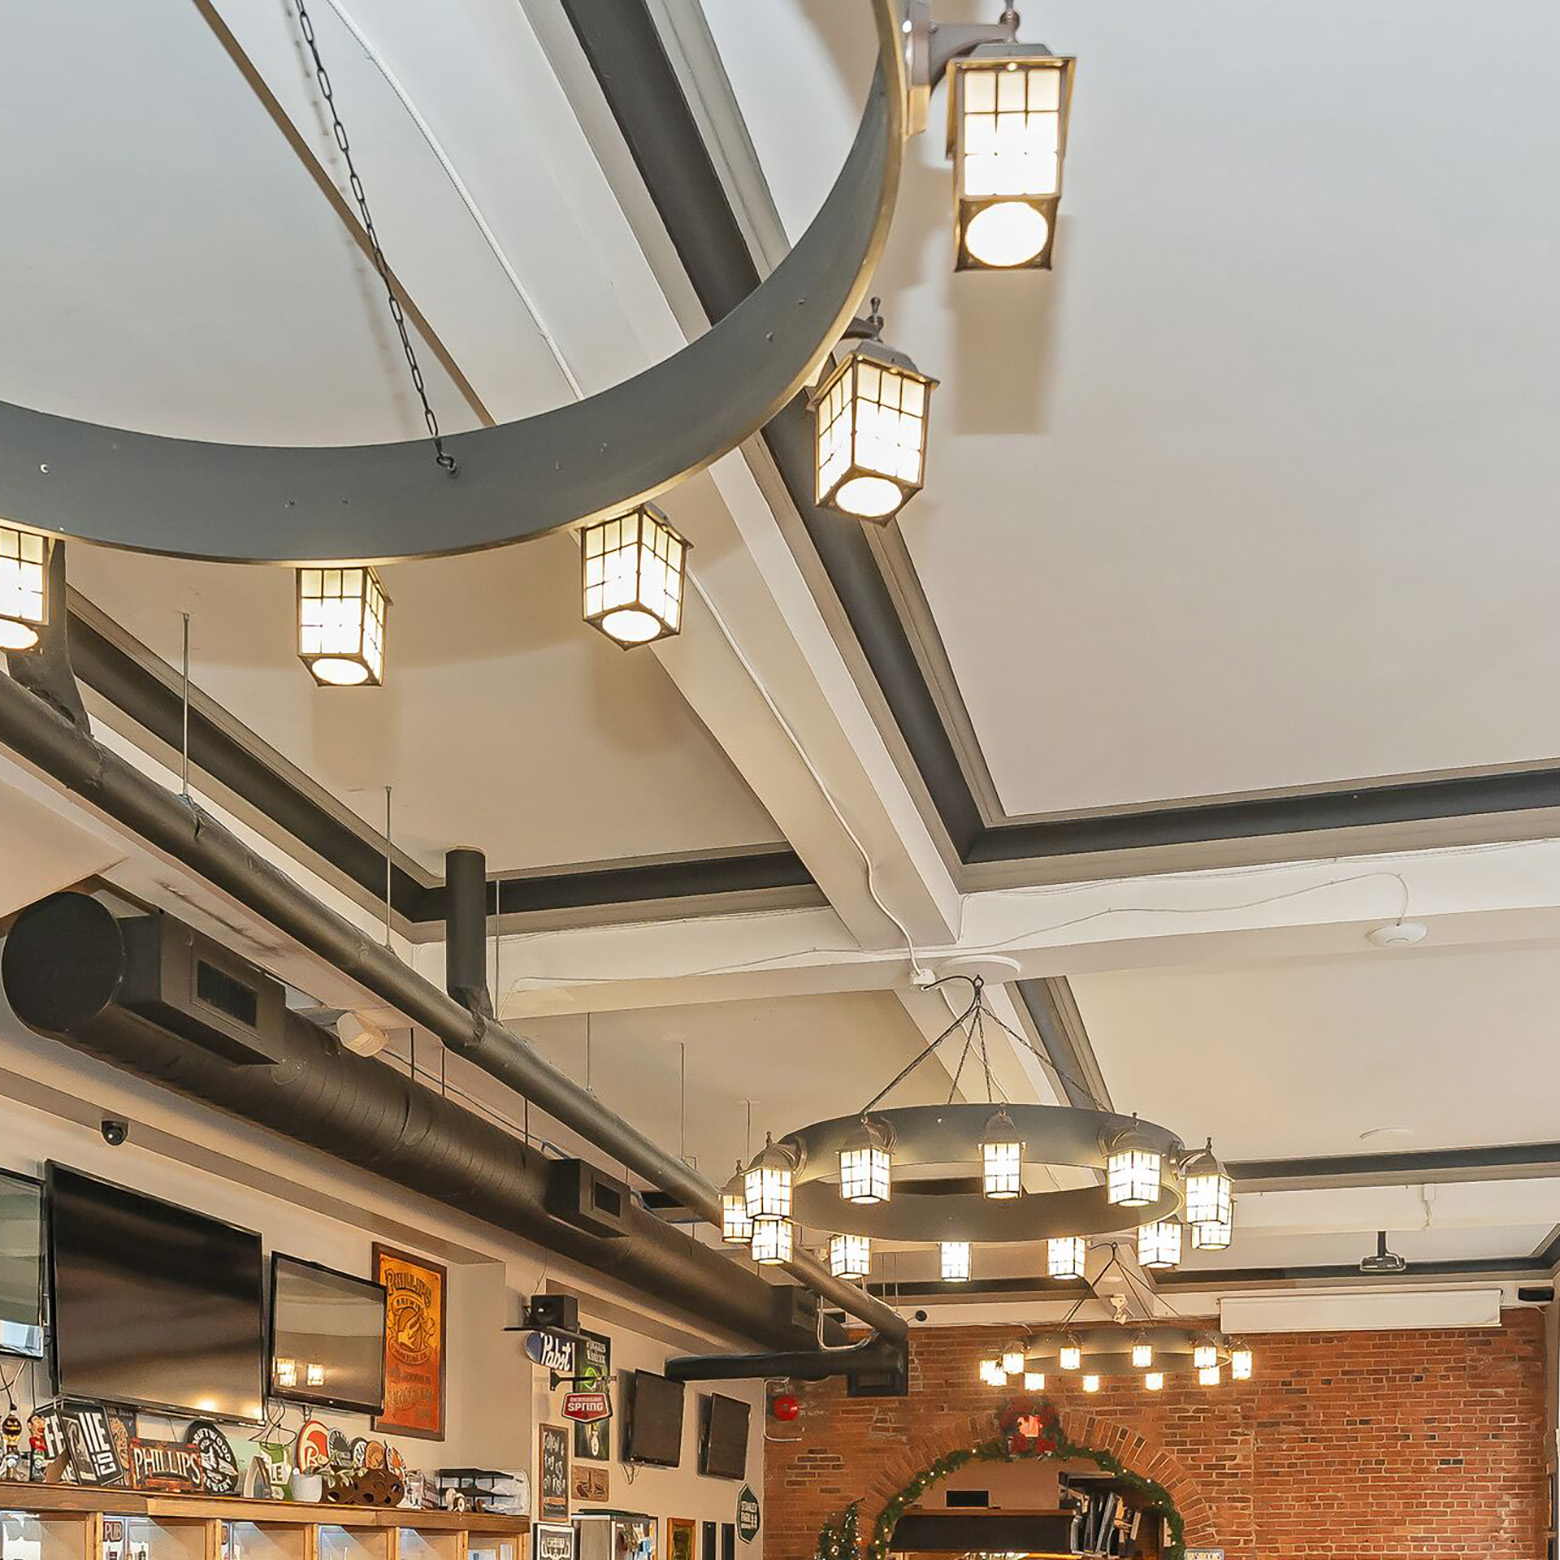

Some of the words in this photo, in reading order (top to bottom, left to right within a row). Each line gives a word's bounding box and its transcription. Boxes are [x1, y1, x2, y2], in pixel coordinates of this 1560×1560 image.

[385, 1269, 432, 1309] PHILLIPS
[540, 1332, 571, 1371] Pabst
[567, 1402, 604, 1412] SPRING
[191, 1426, 233, 1463] DRIFTWOOD
[133, 1447, 202, 1484] PHILLIPS
[105, 1523, 123, 1541] PUB
